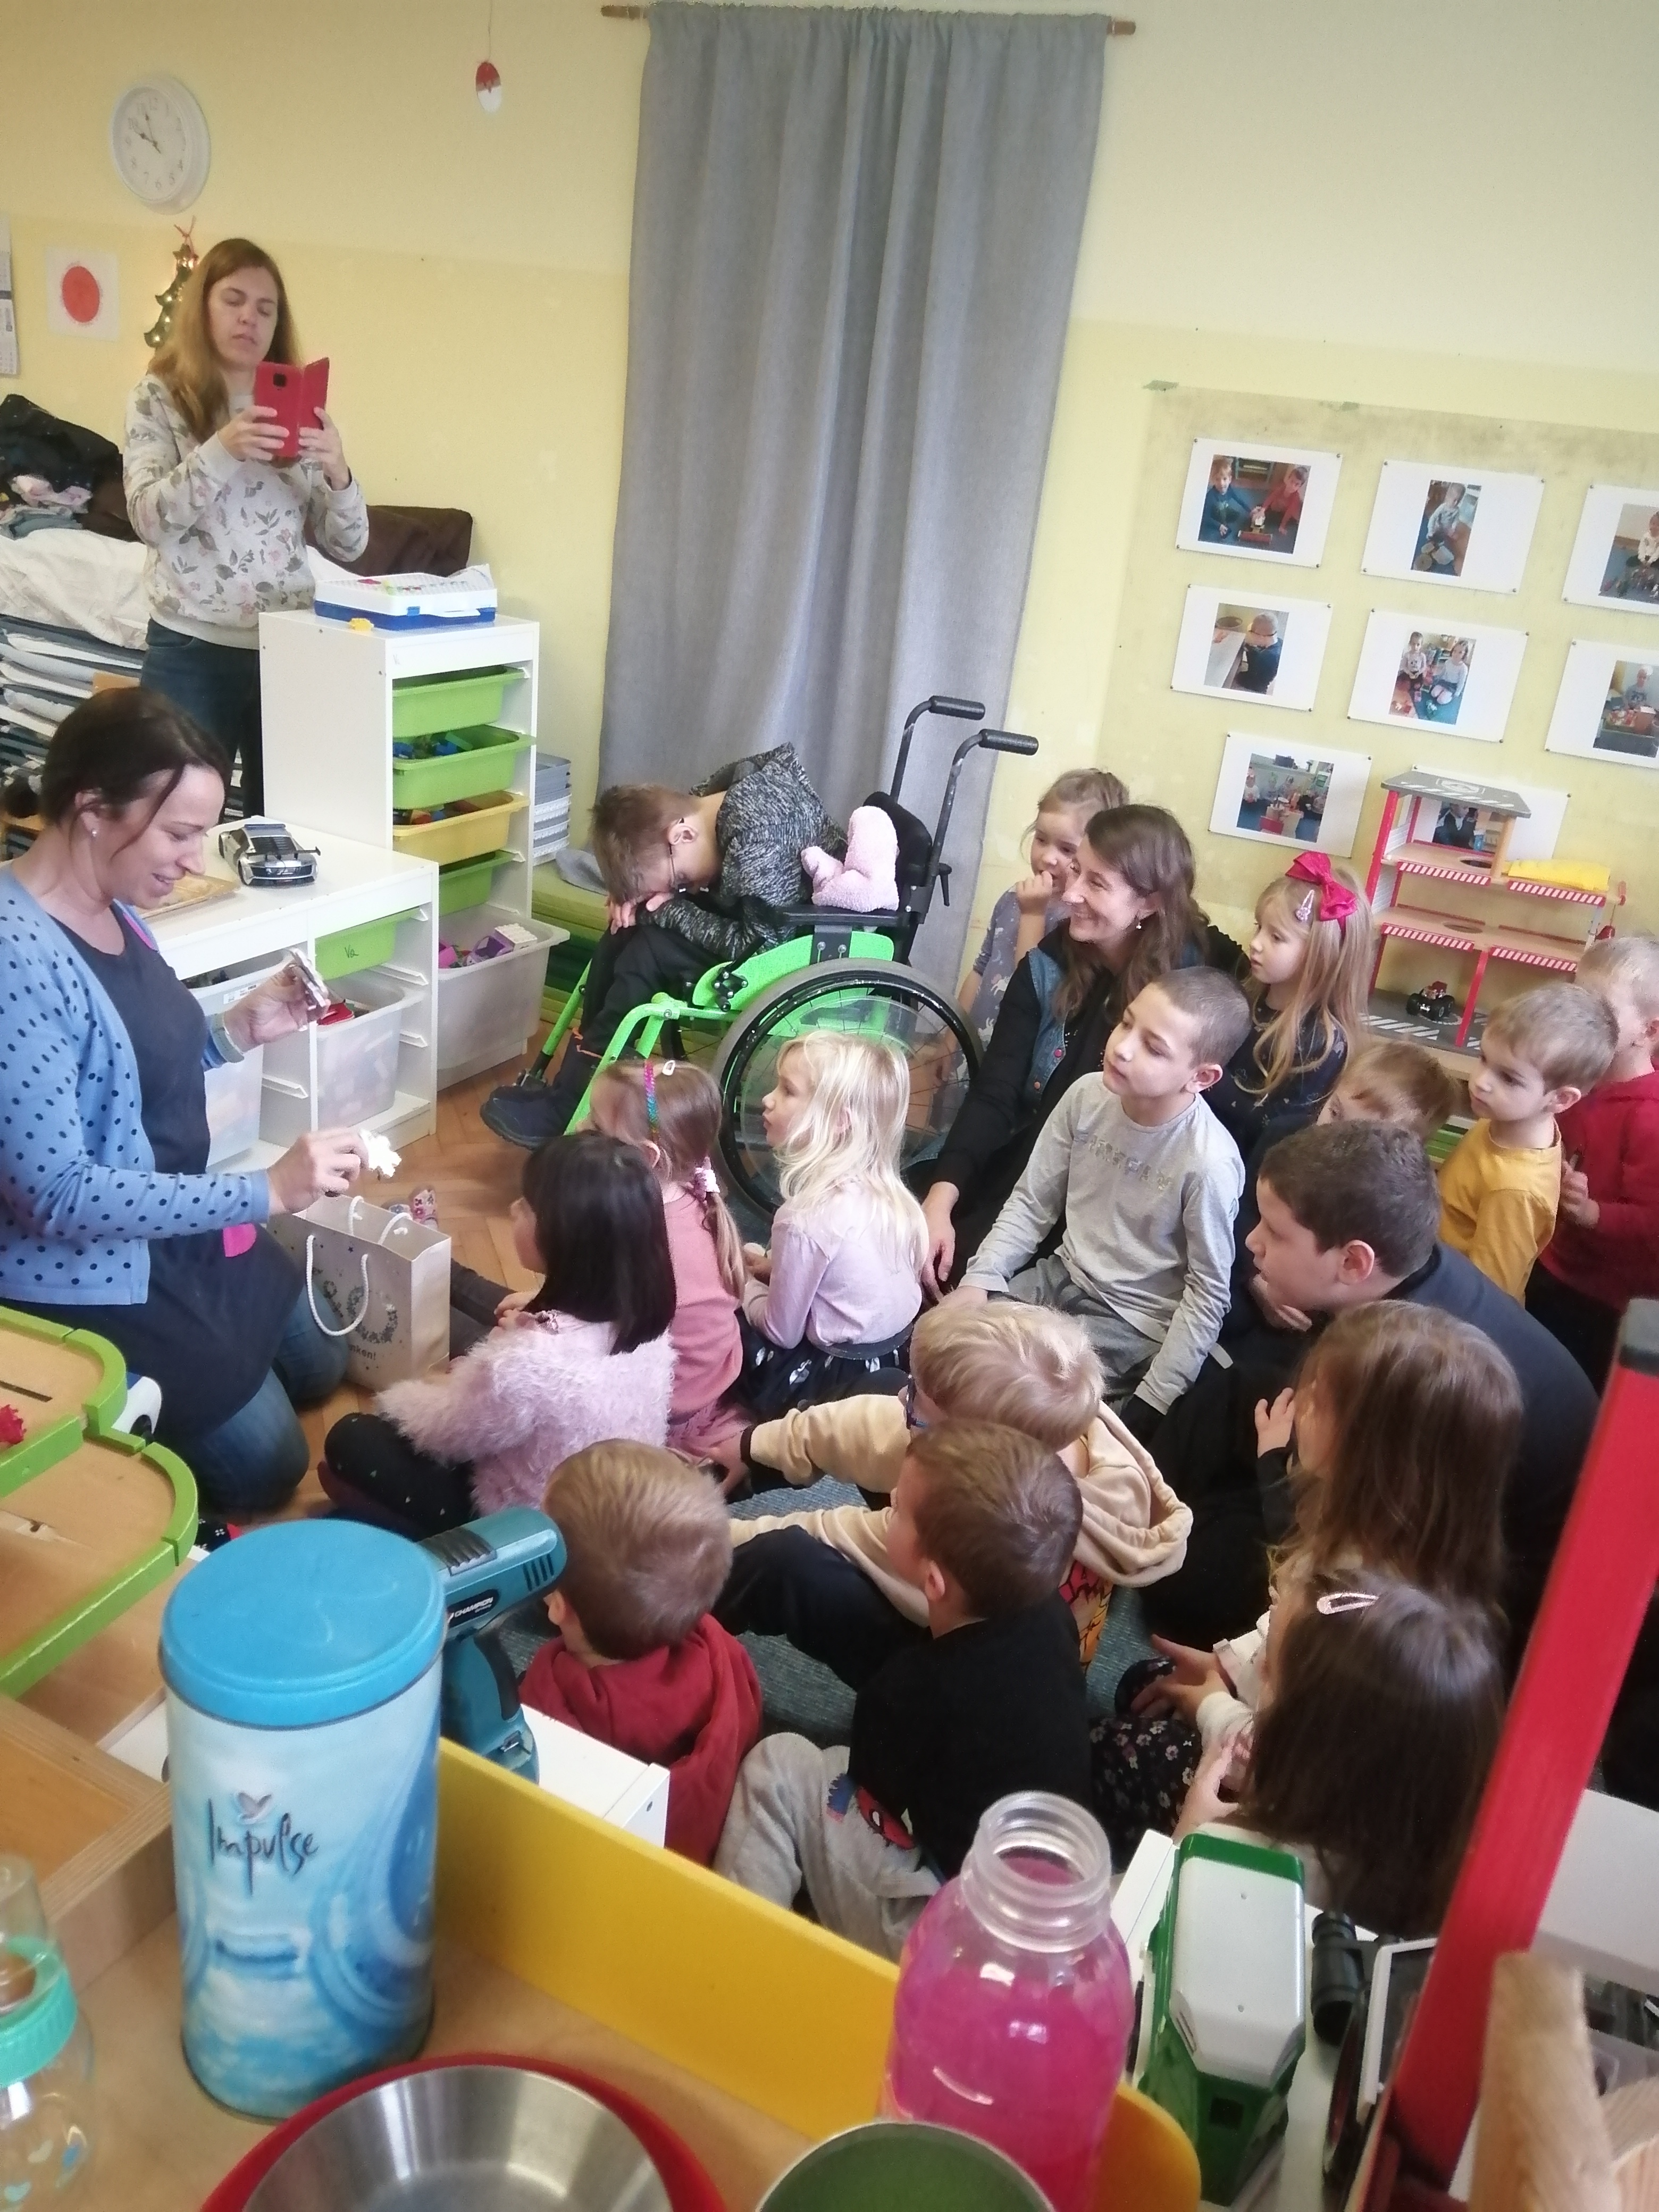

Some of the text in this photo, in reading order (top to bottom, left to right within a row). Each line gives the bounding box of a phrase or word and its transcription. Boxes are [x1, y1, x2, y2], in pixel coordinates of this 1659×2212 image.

[177, 159, 183, 172] 4
[143, 171, 149, 185] 7
[155, 179, 162, 190] 6
[169, 170, 175, 186] 5
[454, 1597, 493, 1618] CHAMPION
[207, 1798, 320, 1897] Impulse
